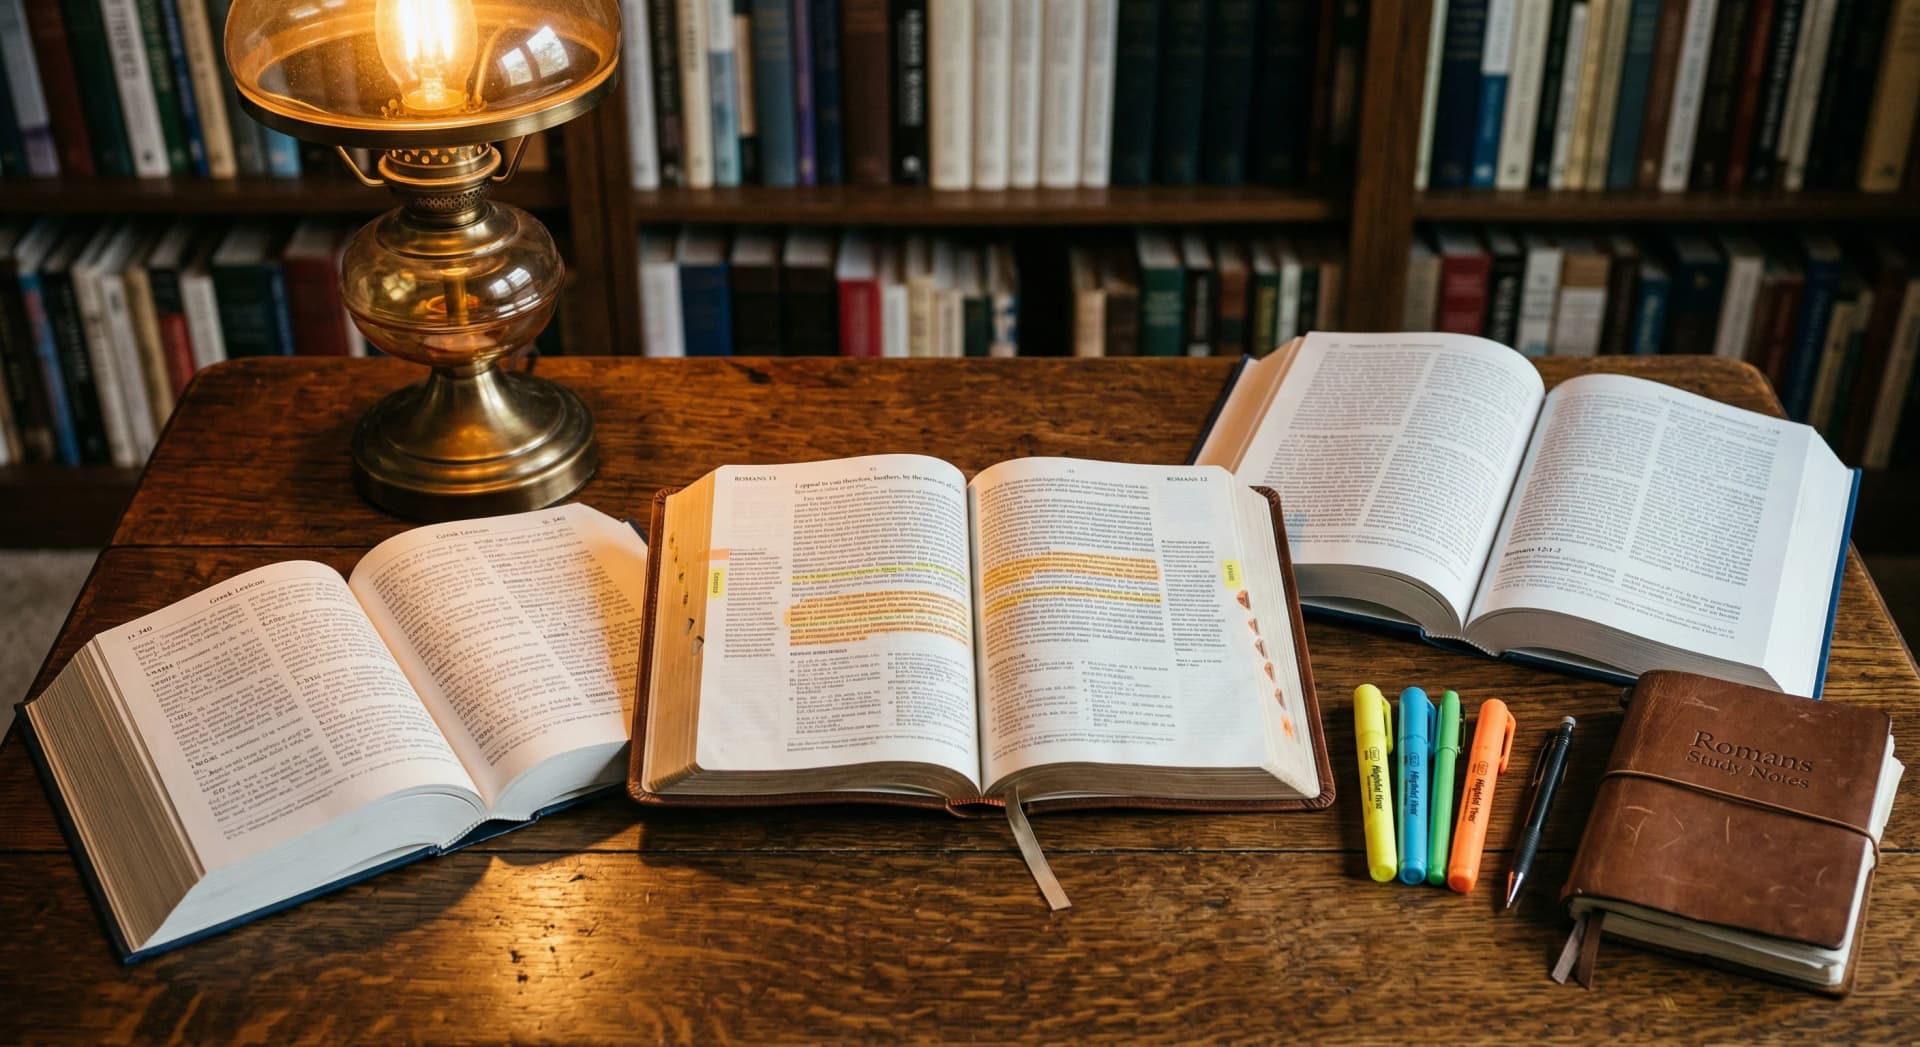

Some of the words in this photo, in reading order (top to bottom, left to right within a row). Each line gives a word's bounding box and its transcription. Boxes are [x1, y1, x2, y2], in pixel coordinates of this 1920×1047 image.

[1685, 750, 1743, 776] Study
[1749, 766, 1809, 789] Notes
[1689, 729, 1814, 773] Romans
